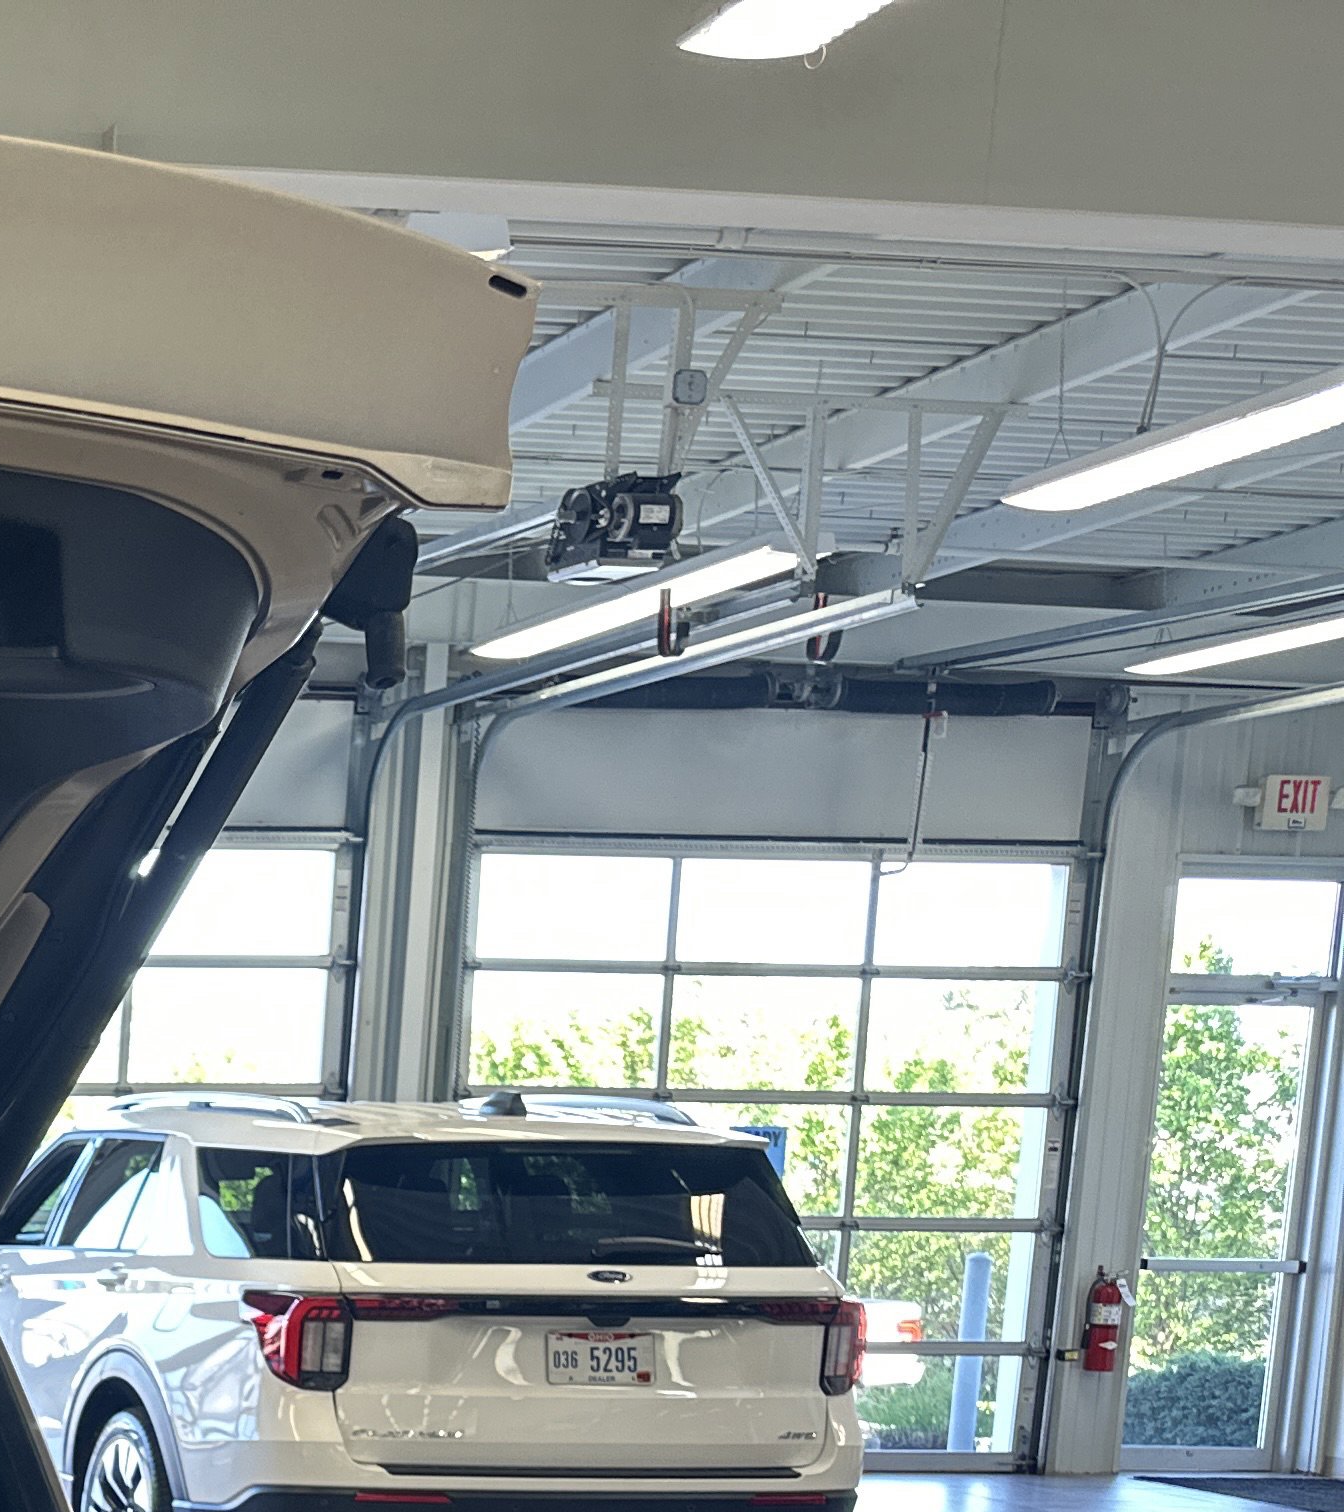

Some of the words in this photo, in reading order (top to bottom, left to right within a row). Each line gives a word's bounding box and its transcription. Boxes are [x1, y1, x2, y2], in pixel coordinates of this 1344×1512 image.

[1277, 780, 1322, 813] EXIT
[588, 1332, 615, 1342] OHIO
[553, 1350, 578, 1369] 036
[589, 1346, 638, 1373] 5295
